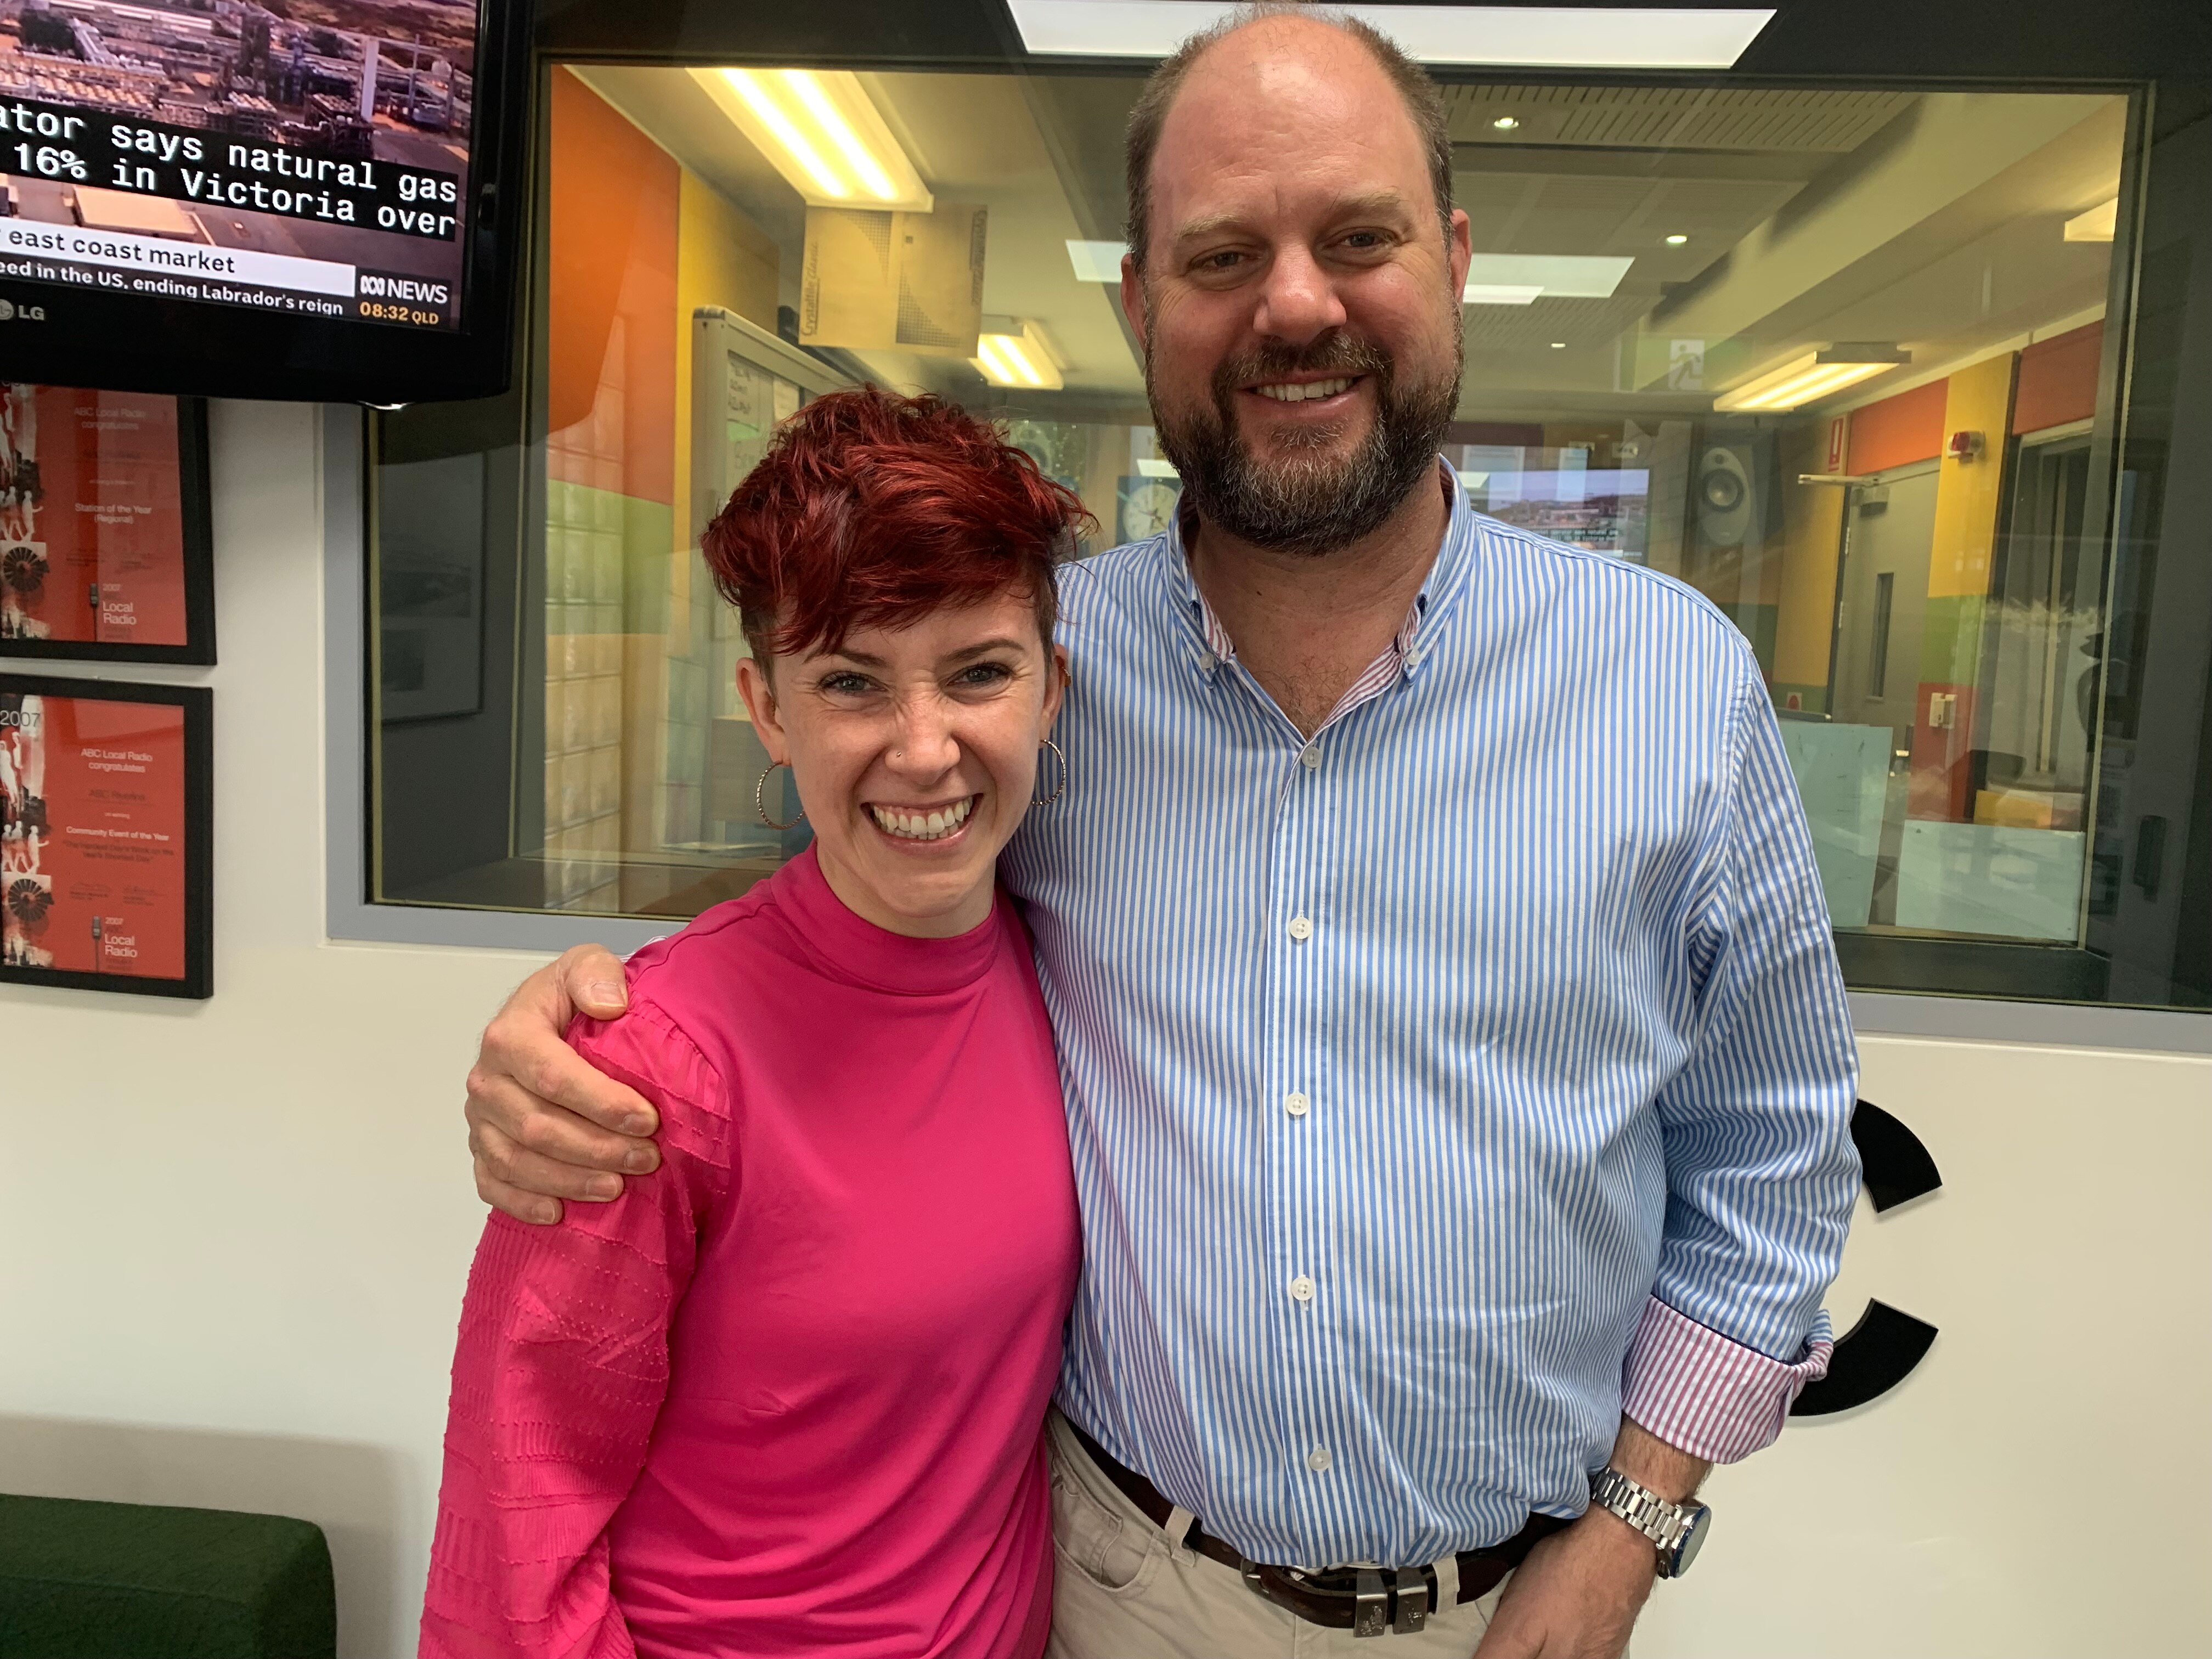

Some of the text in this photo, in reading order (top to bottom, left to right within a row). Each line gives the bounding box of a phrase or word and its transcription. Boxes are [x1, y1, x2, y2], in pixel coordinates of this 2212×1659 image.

[111, 125, 204, 161] says
[229, 144, 377, 189] natural
[399, 173, 457, 202] gas
[14, 143, 455, 235] 16% in Victoria over
[9, 230, 235, 273] east coast market
[37, 263, 55, 279] in
[60, 267, 93, 284] the
[133, 279, 198, 298] ending
[202, 284, 294, 309] Labrador's
[298, 298, 343, 315] reign
[387, 278, 448, 304] NEWS
[19, 305, 44, 320] LG
[360, 302, 439, 325] 08:32 QLD
[75, 503, 105, 512] Station
[117, 505, 131, 513] the
[133, 505, 152, 514] Year
[103, 600, 133, 613] Local
[103, 612, 137, 625] Radio
[0, 710, 41, 727] 2007
[81, 748, 153, 761] ABC Local Radio
[66, 826, 108, 837] Community
[109, 830, 129, 838] Event
[105, 917, 123, 925] 2007
[105, 934, 135, 946] Local
[105, 945, 138, 958] Radio
